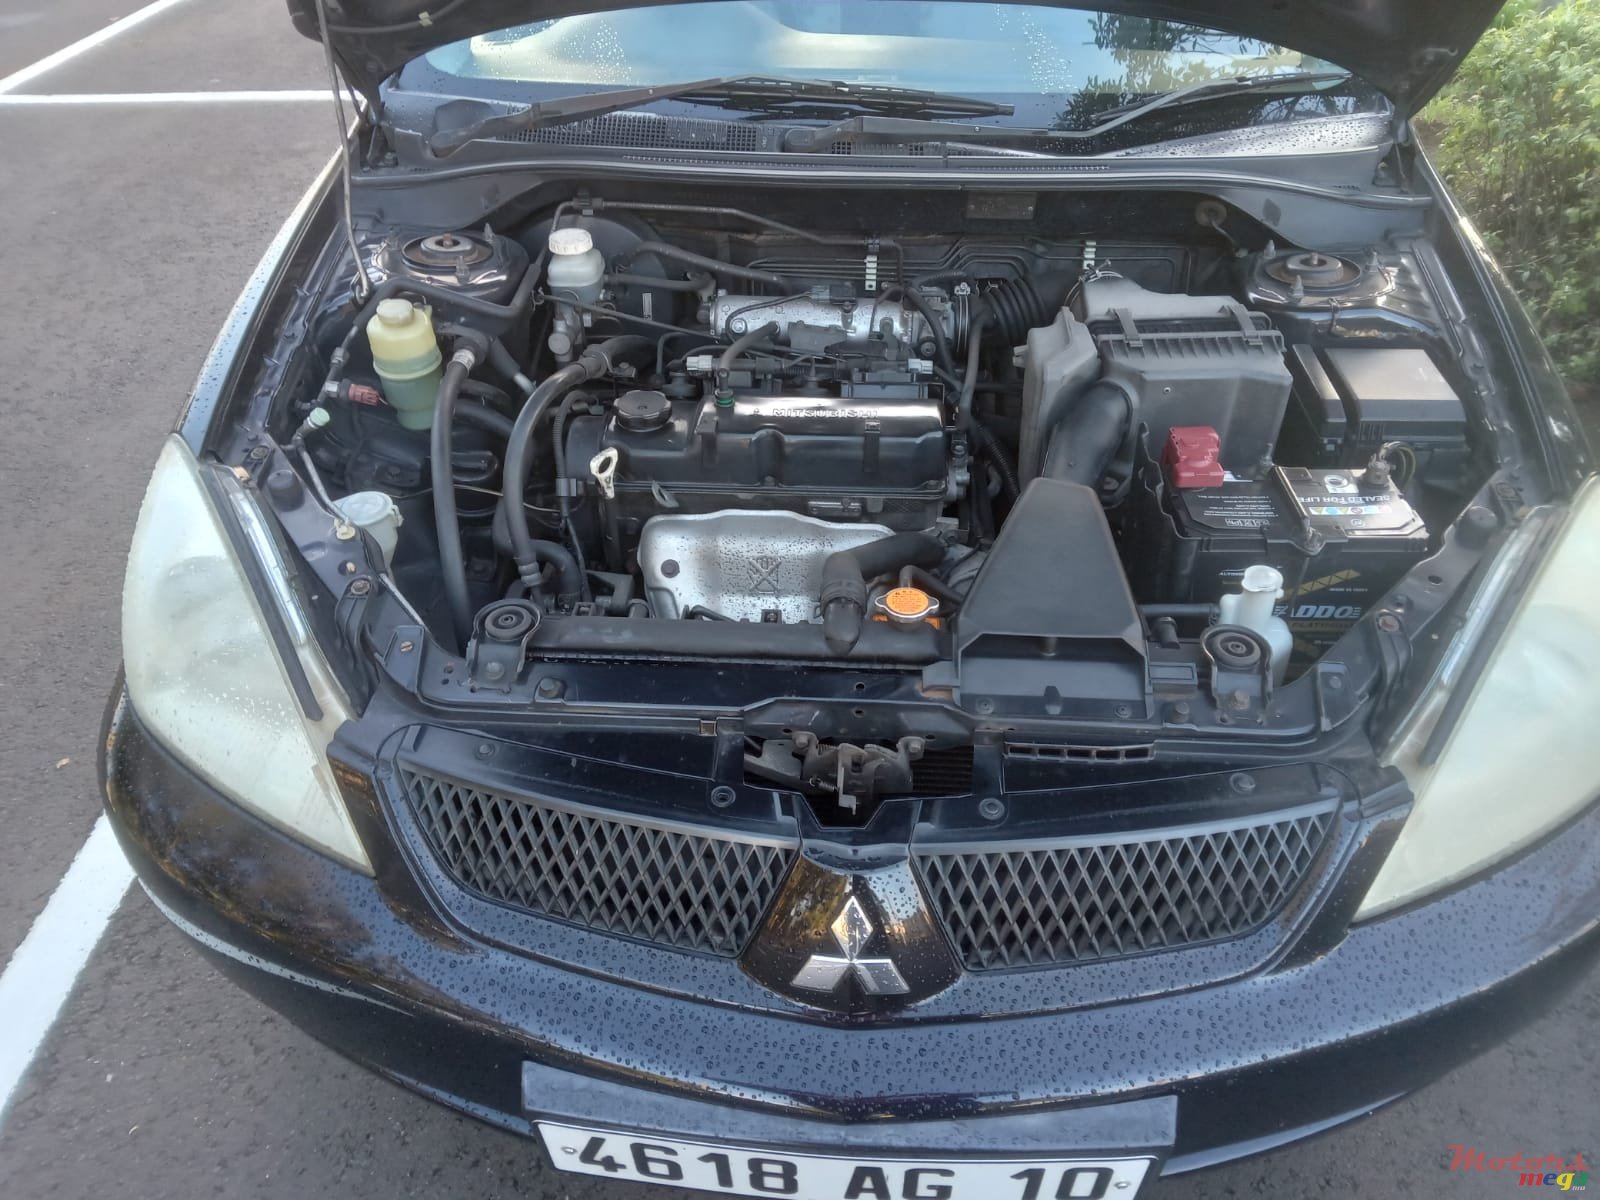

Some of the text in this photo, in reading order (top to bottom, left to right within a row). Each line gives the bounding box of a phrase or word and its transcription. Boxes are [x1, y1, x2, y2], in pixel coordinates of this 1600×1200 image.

[773, 408, 879, 419] MITSUBISHI
[579, 1136, 1114, 1200] 4618 AG 10
